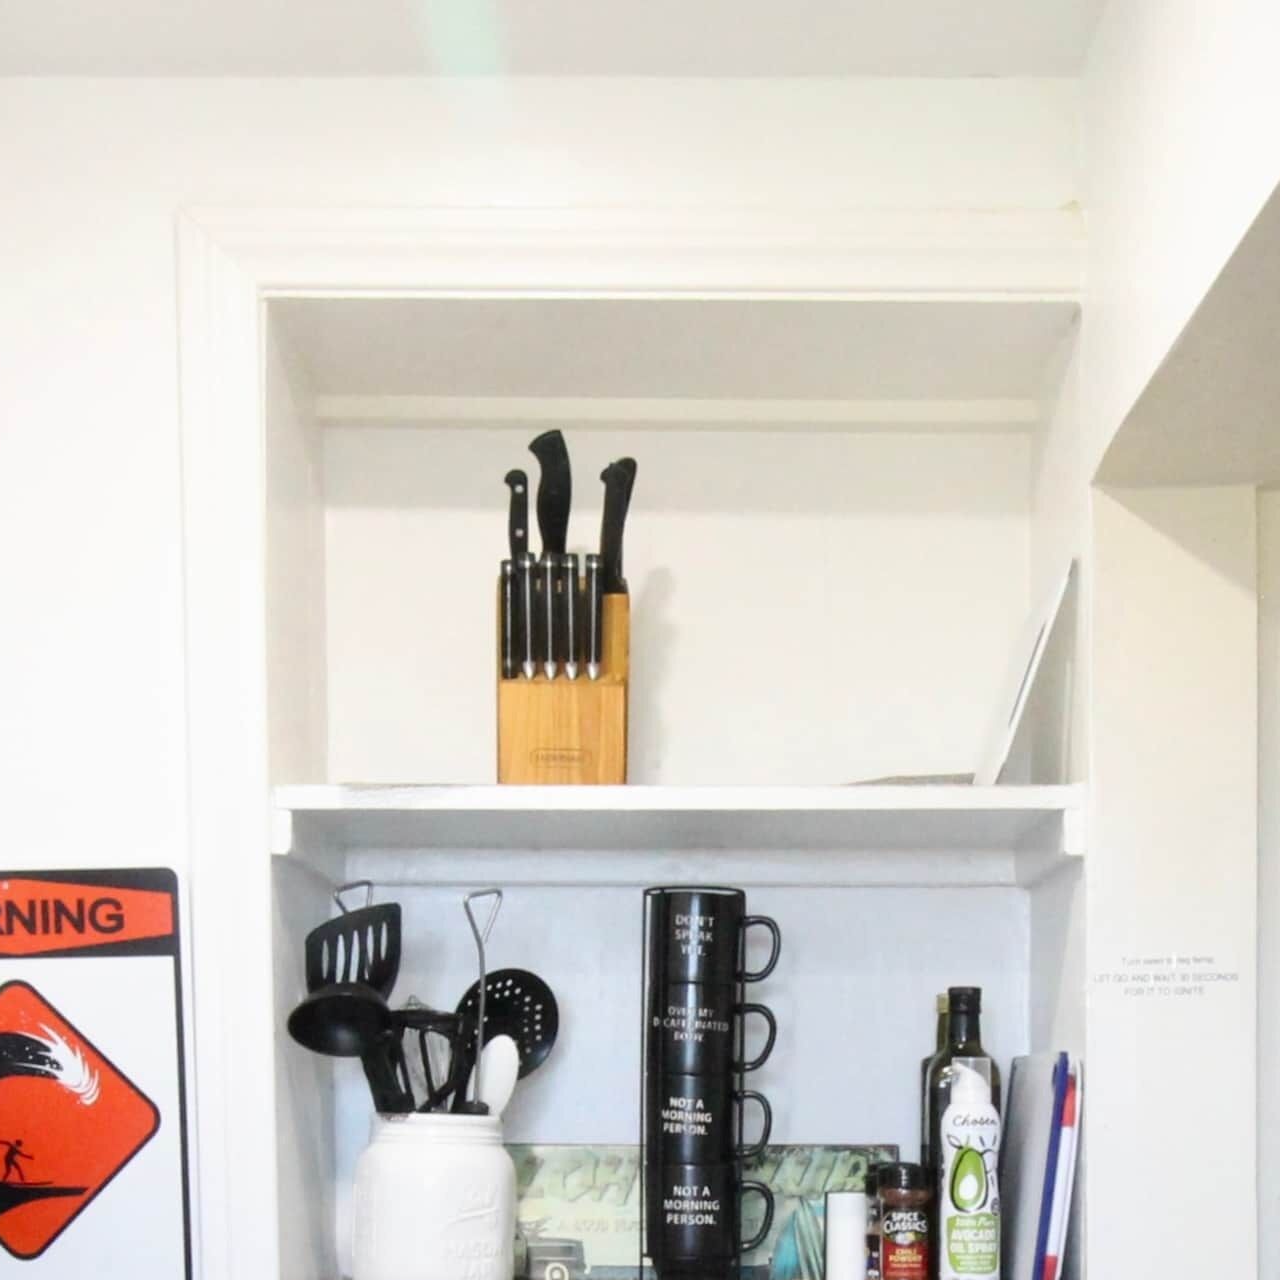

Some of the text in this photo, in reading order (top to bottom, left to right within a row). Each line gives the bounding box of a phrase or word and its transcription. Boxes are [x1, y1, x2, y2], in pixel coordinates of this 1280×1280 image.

[668, 1005, 696, 1017] OVE
[673, 1030, 704, 1043] BOY
[670, 1097, 704, 1110] NOT A
[661, 1109, 712, 1123] MORNING
[663, 1122, 708, 1136] PERSON.
[673, 1186, 711, 1197] NOT A
[664, 1199, 720, 1211] MORNING
[666, 1213, 717, 1225] PERSON.
[891, 1211, 918, 1221] SPICE
[884, 1220, 928, 1234] CLASSICS
